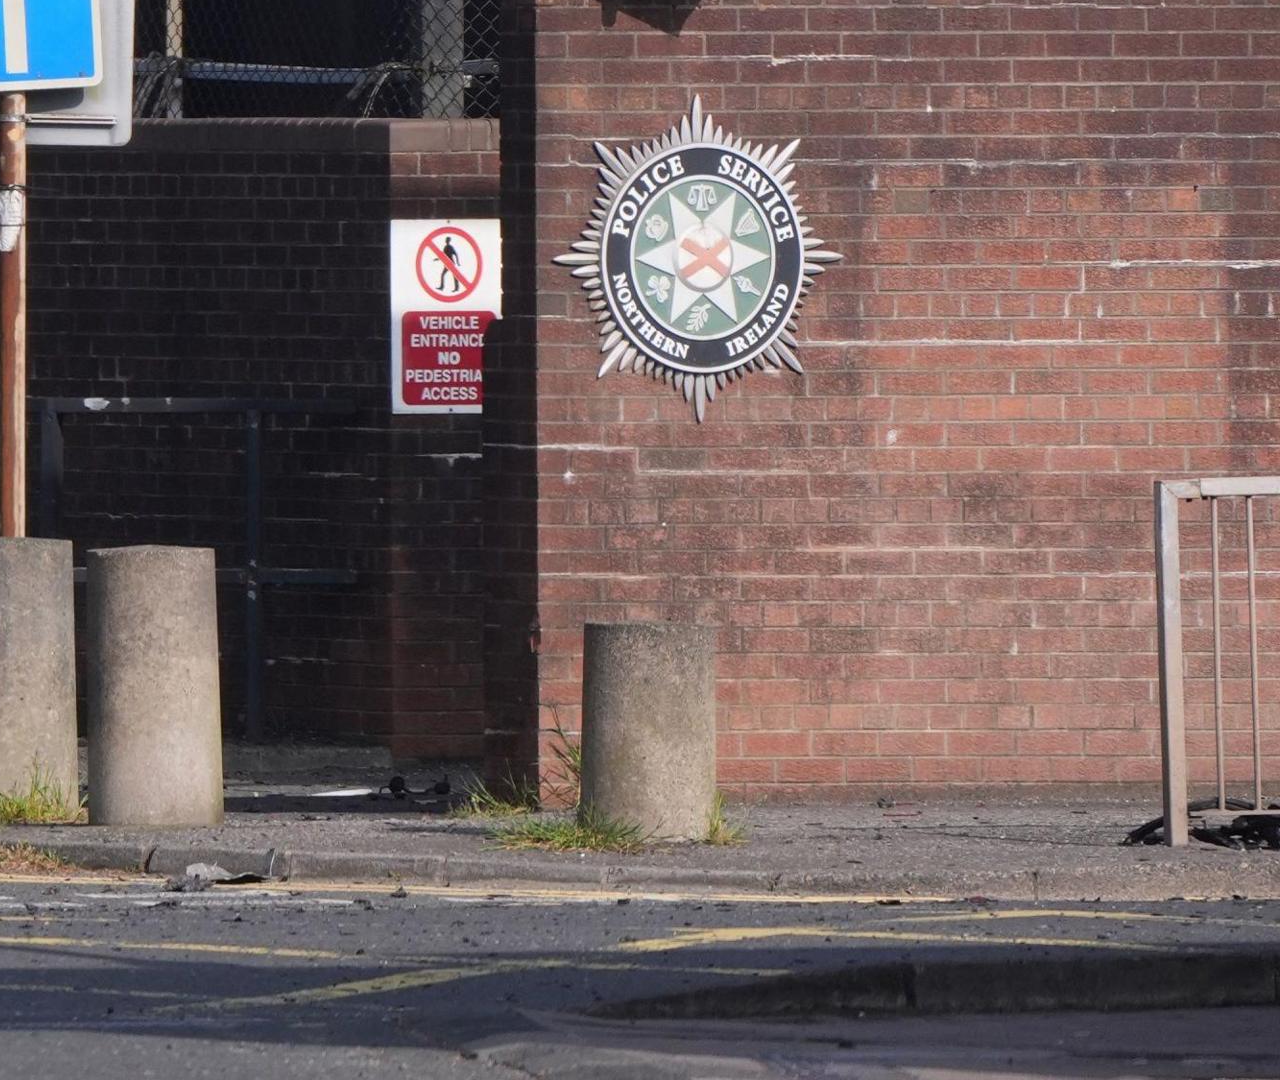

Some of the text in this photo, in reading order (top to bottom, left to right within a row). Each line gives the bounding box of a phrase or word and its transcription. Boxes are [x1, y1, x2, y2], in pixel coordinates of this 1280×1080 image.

[612, 155, 794, 243] POLICE SERVICE
[420, 316, 479, 329] VEHICLE
[612, 272, 790, 360] NORTHERN IRELAND
[438, 352, 460, 365] NO
[405, 369, 482, 382] PEDESTRIA
[421, 387, 478, 400] ACCESS
